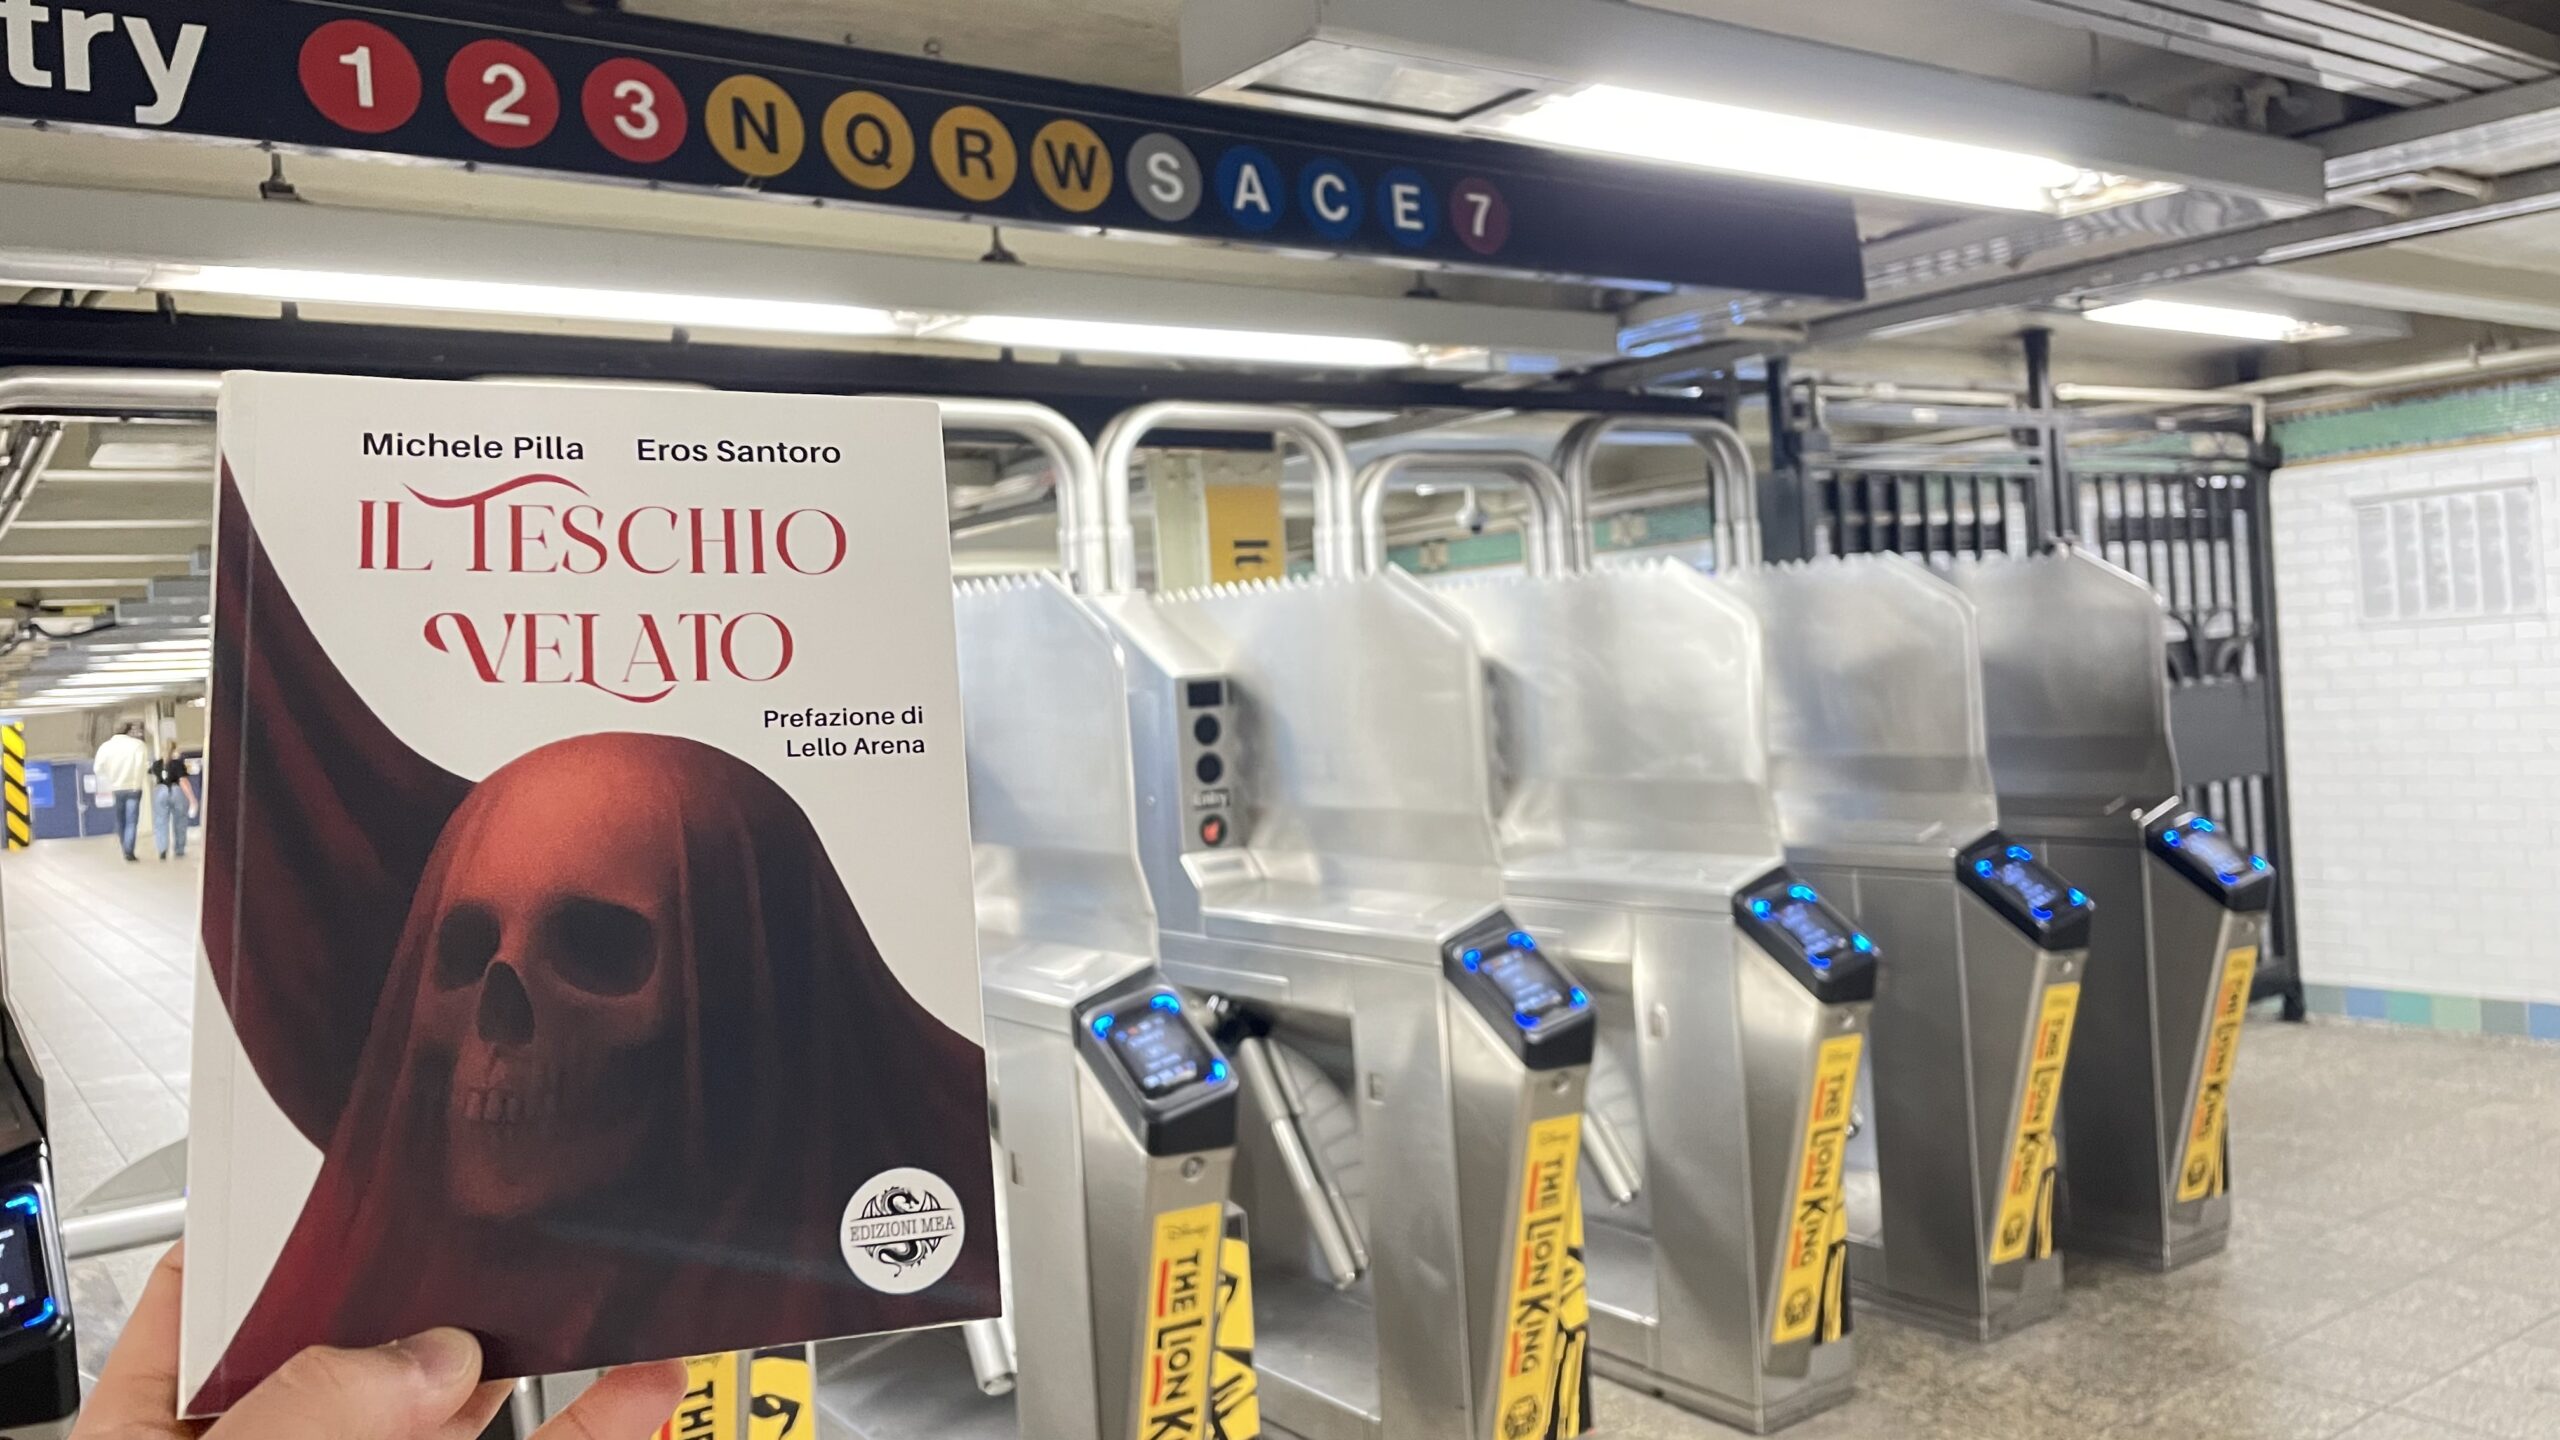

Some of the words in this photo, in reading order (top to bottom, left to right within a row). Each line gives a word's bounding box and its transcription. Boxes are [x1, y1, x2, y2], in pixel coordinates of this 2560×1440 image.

[339, 46, 374, 108] 1
[482, 63, 531, 127] 2
[613, 79, 659, 140] 3
[731, 97, 780, 154] N
[846, 113, 892, 170] Q
[955, 127, 995, 181] R
[1044, 139, 1097, 192] W
[1147, 153, 1184, 202] S
[1233, 164, 1270, 213] A
[1312, 174, 1349, 221] C
[1391, 185, 1424, 230] E
[1465, 193, 1491, 237] 7
[361, 432, 503, 459] Michele
[513, 435, 584, 461] Pilla
[637, 438, 708, 463] Eros
[716, 440, 841, 464] Santoro
[358, 500, 433, 571] IL
[402, 473, 847, 575] TESCHIO
[423, 612, 794, 703] VELATO
[763, 706, 895, 729] Prefazione
[901, 705, 924, 726] di
[786, 737, 847, 757] Lello
[853, 737, 925, 757] Arena
[1541, 1153, 1565, 1208] THE
[1811, 1125, 1841, 1188] LION
[850, 1220, 917, 1242] EDIZIONI
[921, 1215, 956, 1234] MEA
[1526, 1214, 1562, 1286] LION
[1799, 1195, 1830, 1266] KING
[1172, 1250, 1200, 1314] THE
[1157, 1318, 1203, 1401] LION
[1517, 1293, 1550, 1375] KING
